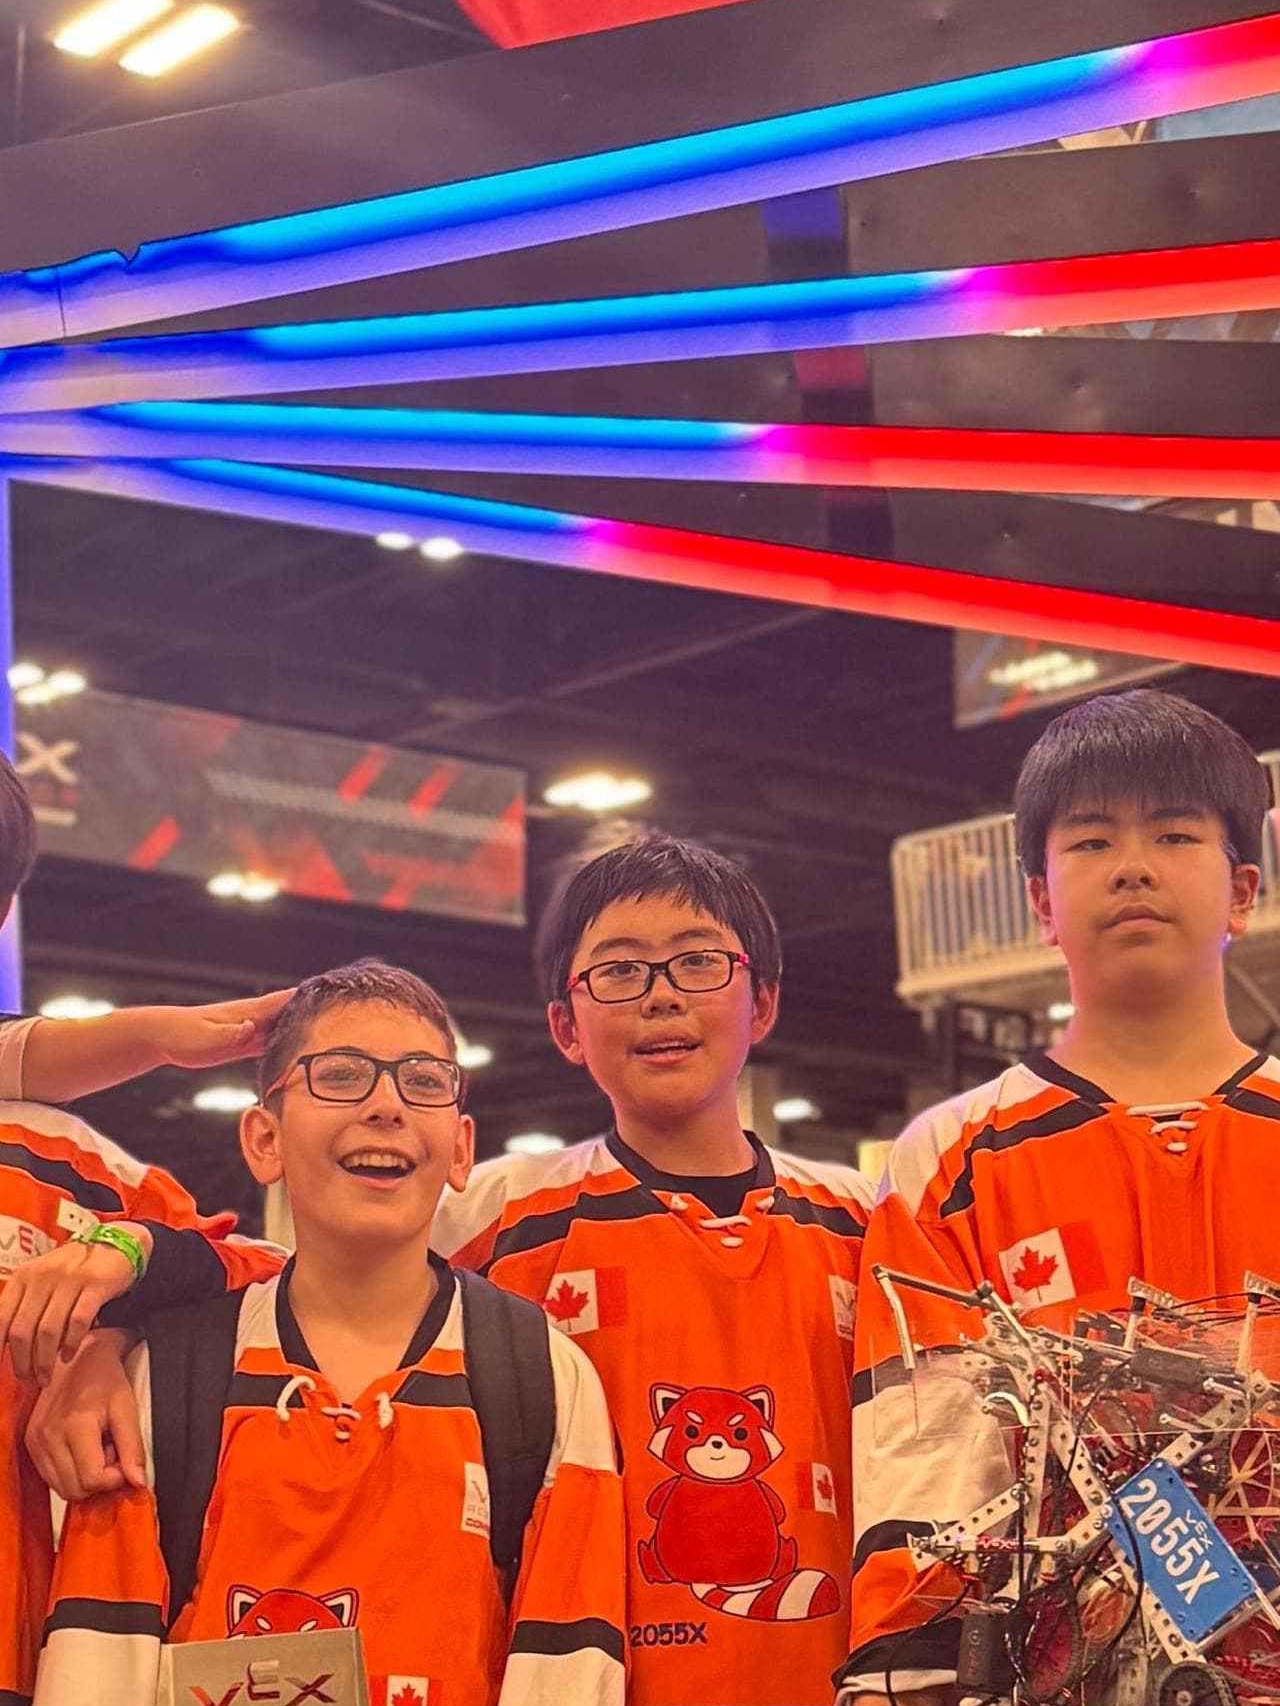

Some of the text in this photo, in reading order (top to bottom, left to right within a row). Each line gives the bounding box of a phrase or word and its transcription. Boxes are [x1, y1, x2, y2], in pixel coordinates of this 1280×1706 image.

[1120, 1478, 1220, 1605] 2055X
[1185, 1509, 1214, 1550] VEX
[630, 1622, 707, 1647] 2055X
